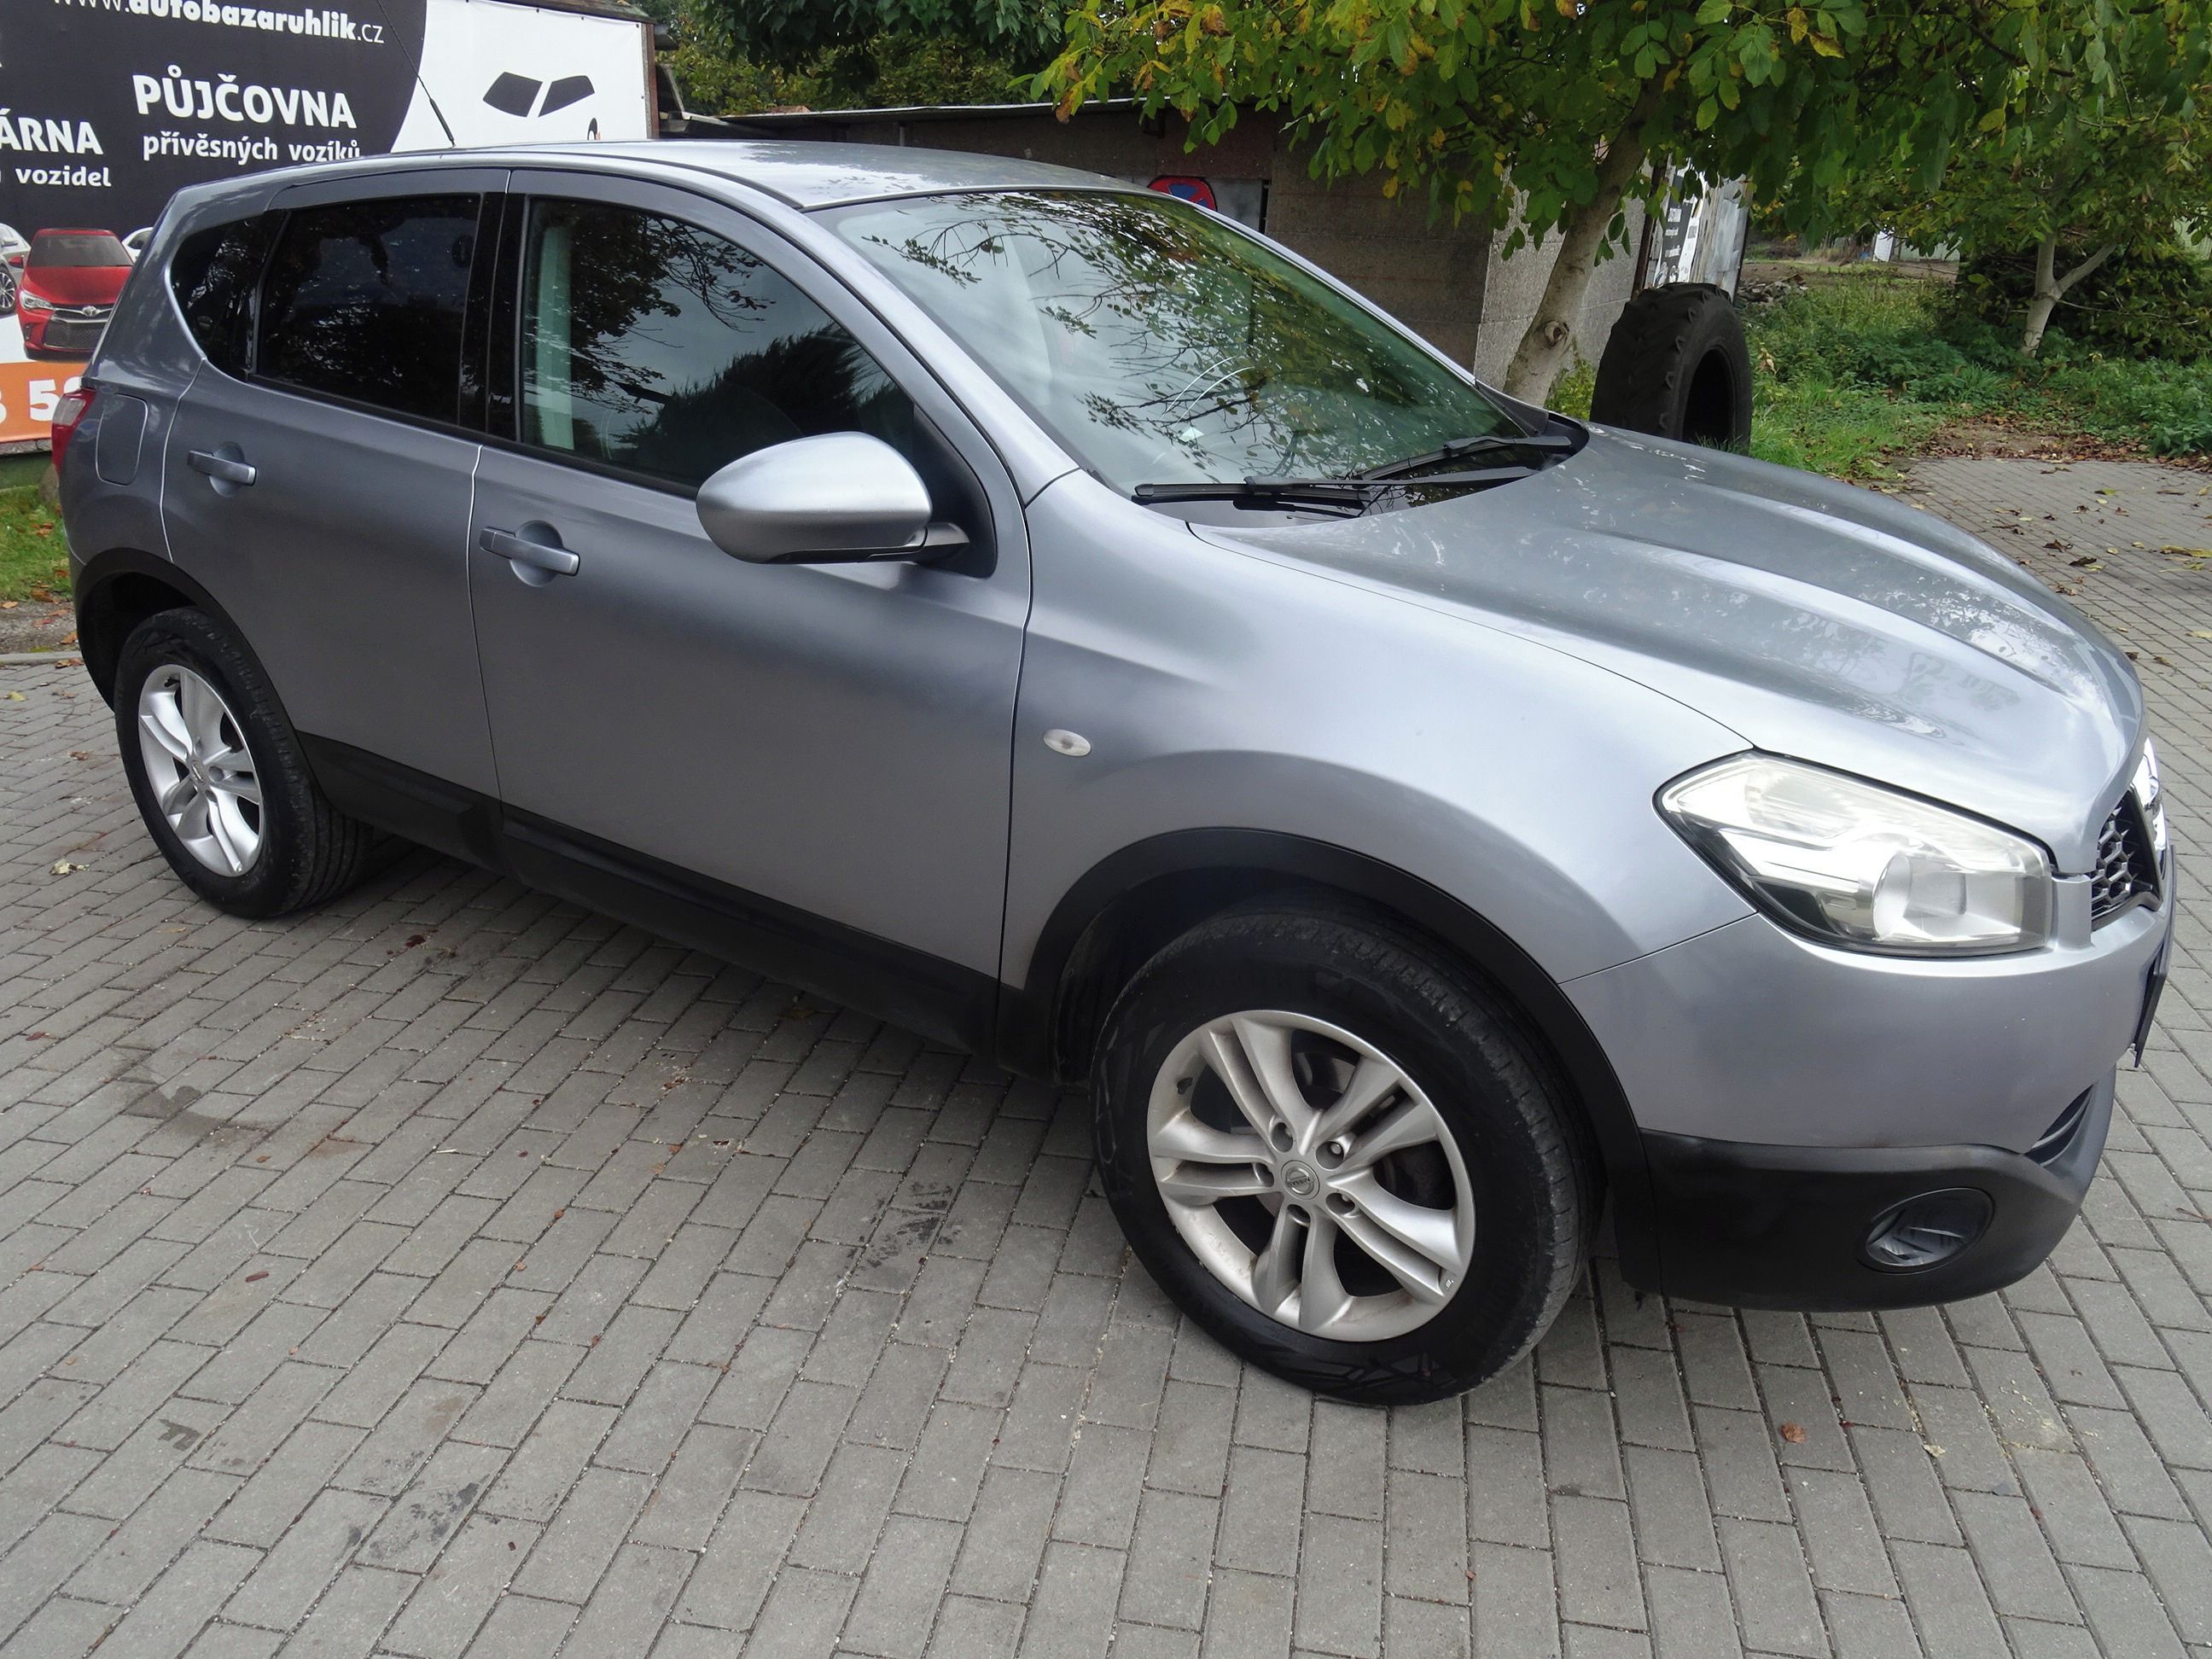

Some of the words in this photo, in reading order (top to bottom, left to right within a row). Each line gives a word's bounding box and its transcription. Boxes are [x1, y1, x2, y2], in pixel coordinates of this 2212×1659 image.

[132, 65, 357, 129] PŮJČOVNA
[143, 131, 277, 165] přívěsných
[288, 140, 360, 161] vozíků
[15, 166, 112, 187] vozidel
